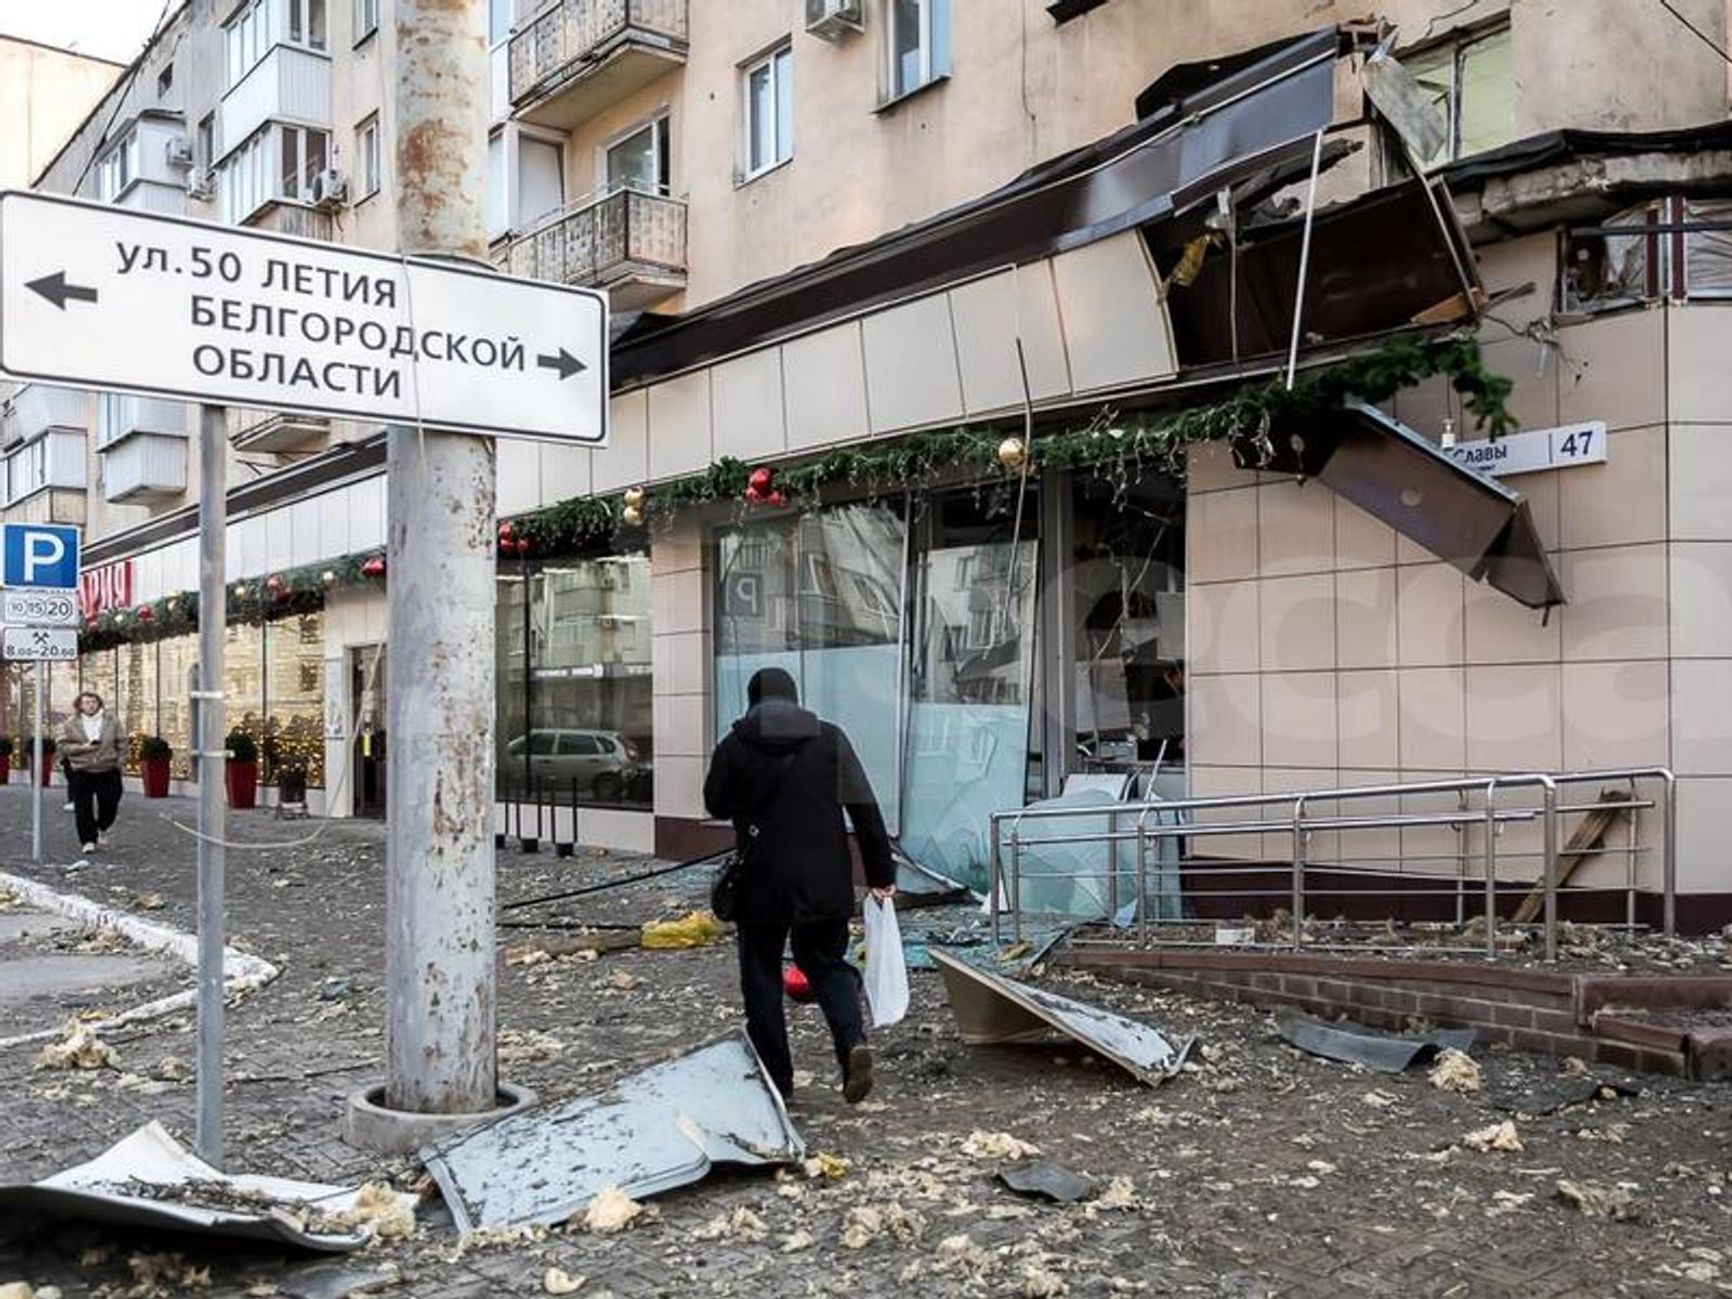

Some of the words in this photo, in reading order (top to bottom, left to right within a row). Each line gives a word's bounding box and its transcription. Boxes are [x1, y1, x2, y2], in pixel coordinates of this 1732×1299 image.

[261, 259, 397, 309] ЛЕТИЯ
[191, 294, 526, 372] БЕЛГОРОДСКОЙ
[193, 344, 401, 400] ОБЛАСТИ
[1560, 431, 1593, 457] 47
[24, 531, 65, 582] P
[48, 601, 69, 616] 20
